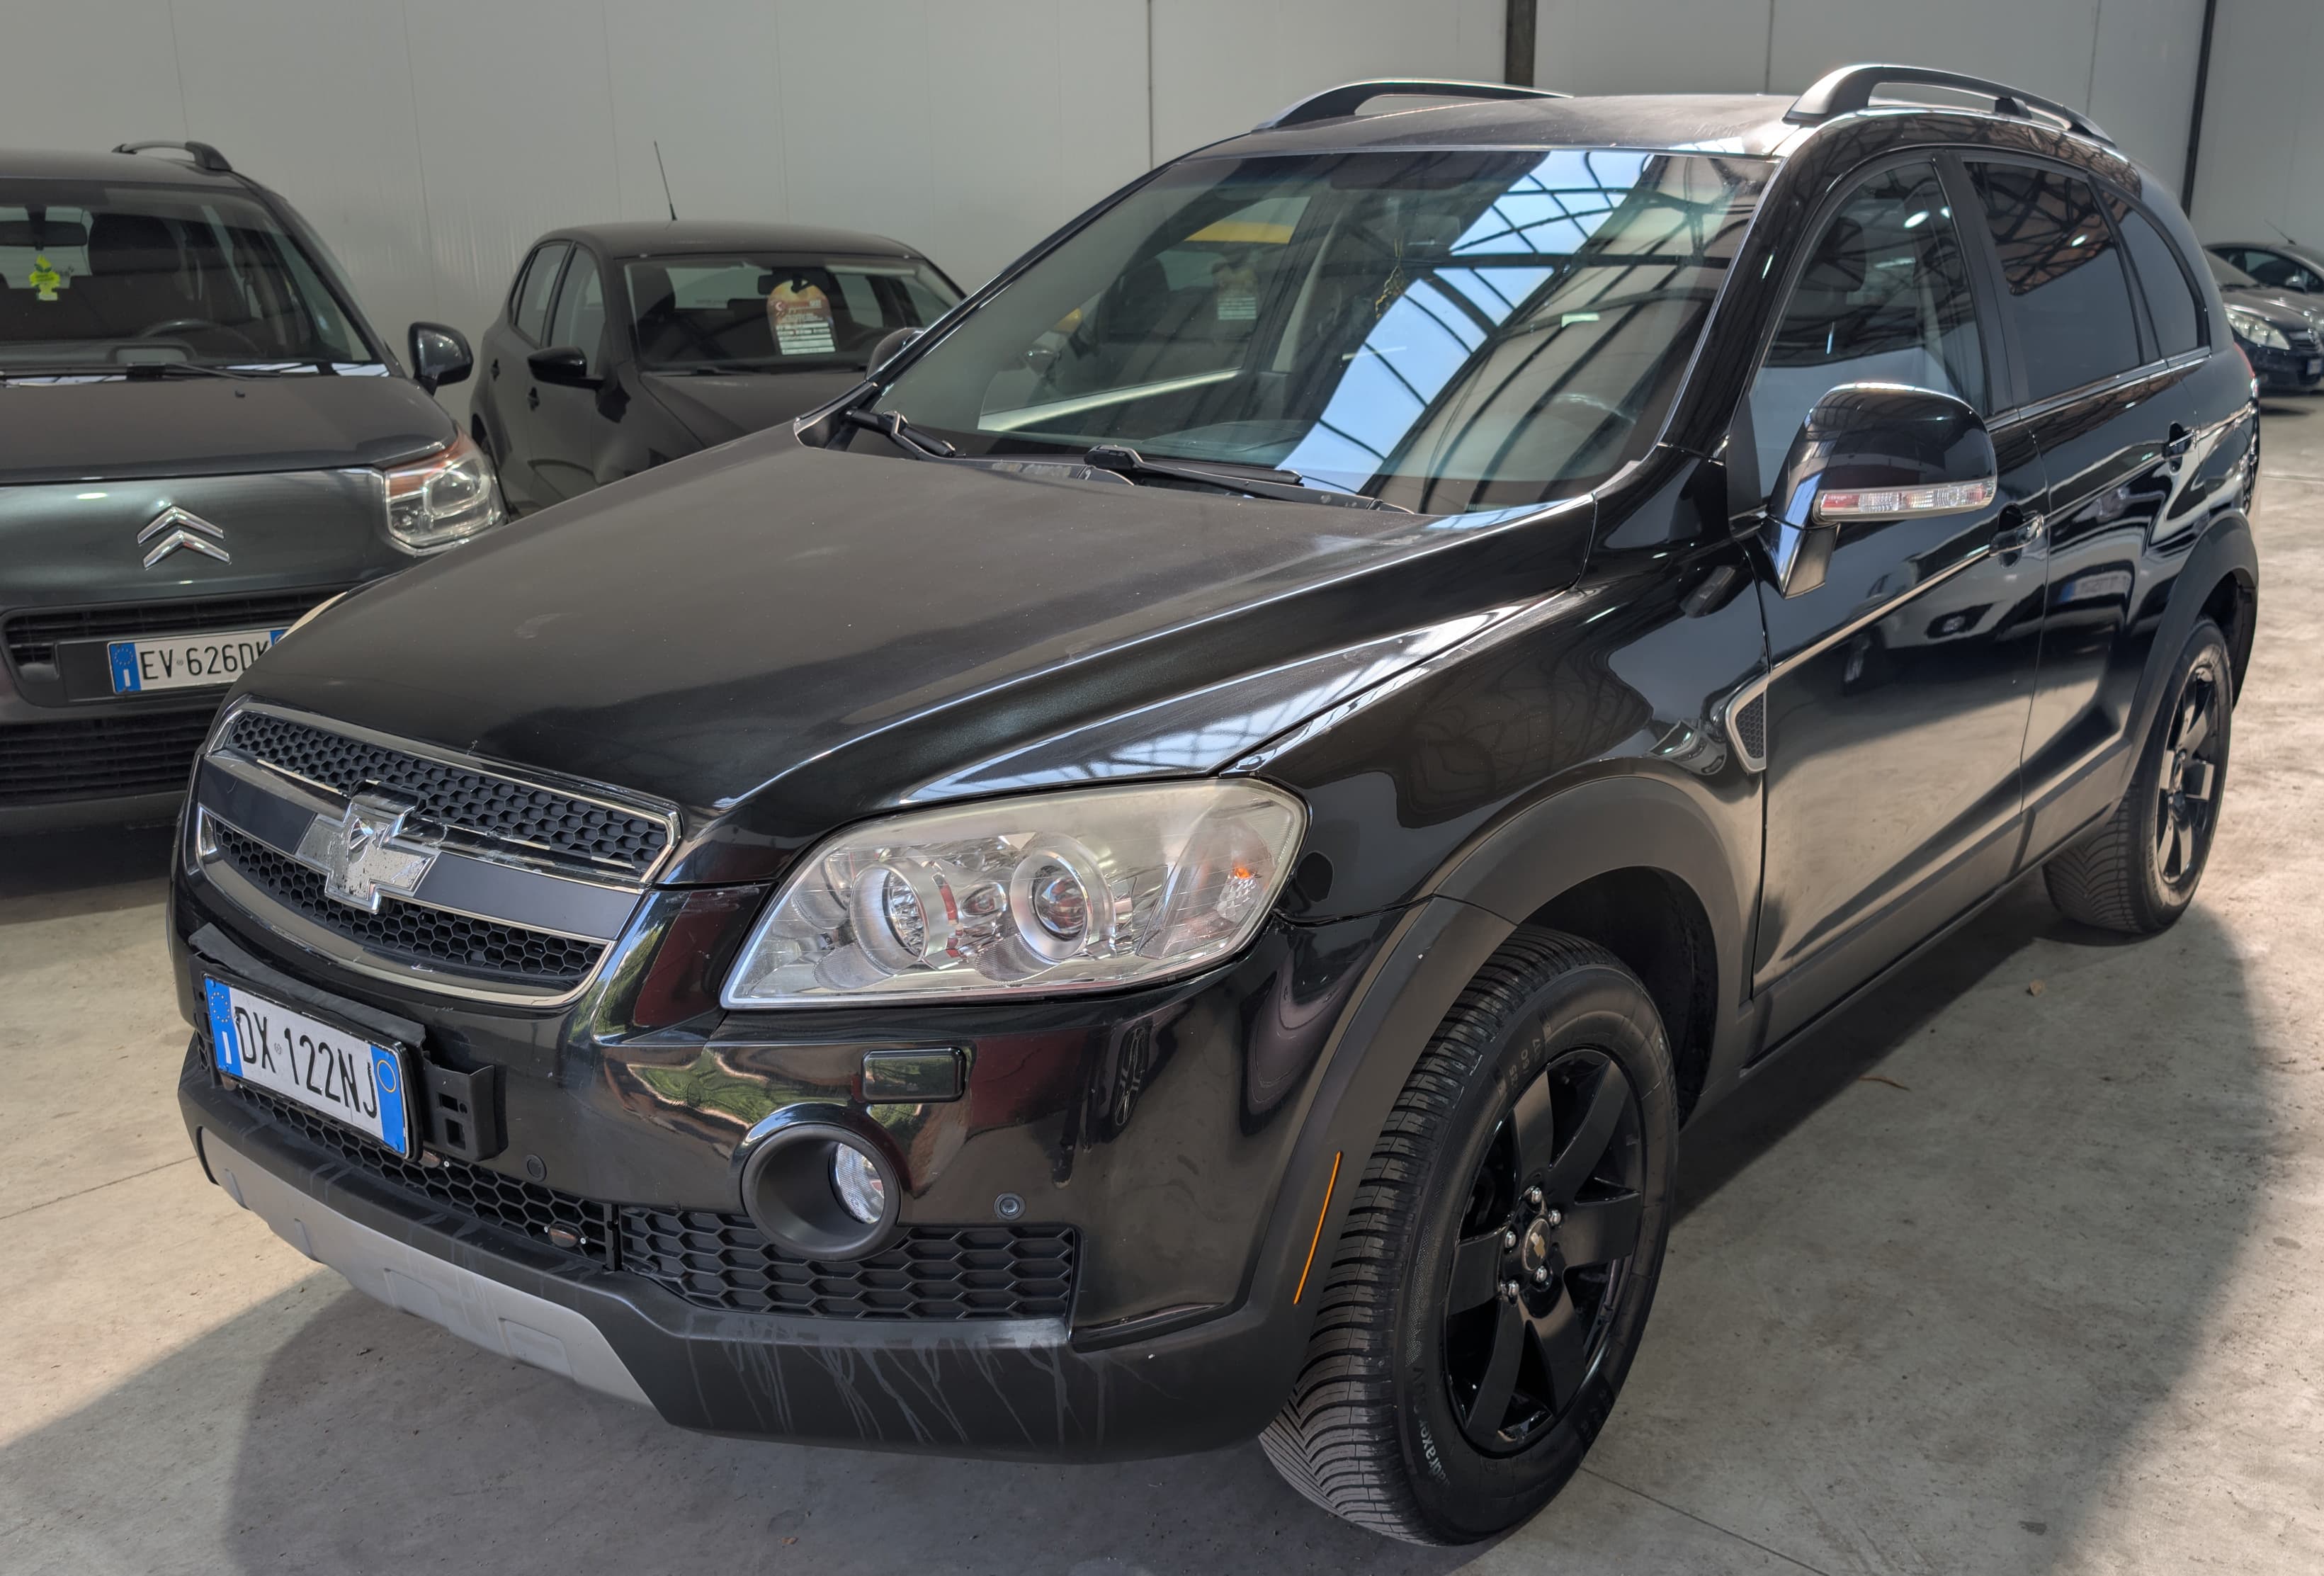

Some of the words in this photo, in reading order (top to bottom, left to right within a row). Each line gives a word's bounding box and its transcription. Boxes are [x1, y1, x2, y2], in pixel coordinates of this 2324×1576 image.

[139, 649, 174, 680] EV
[222, 1031, 232, 1065] I
[234, 1006, 276, 1074] DX
[284, 1027, 378, 1119] 122NJ
